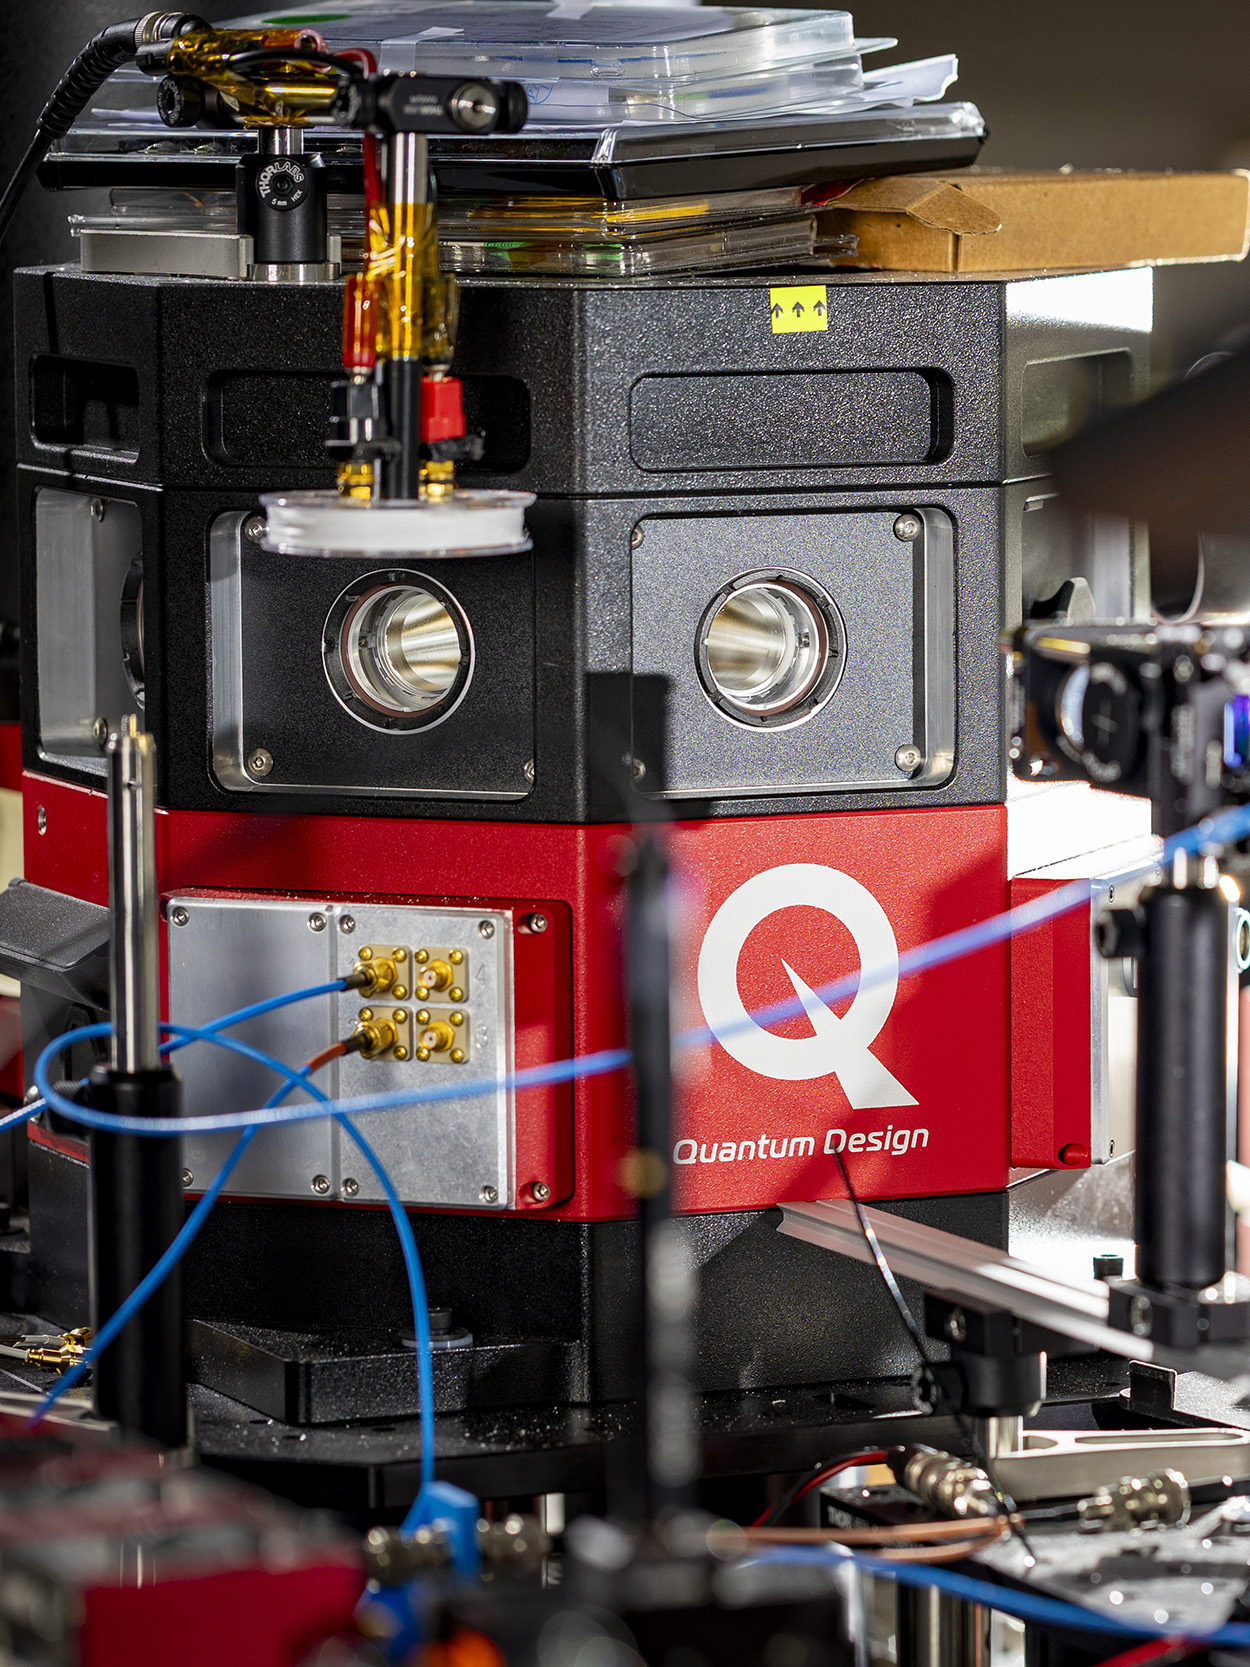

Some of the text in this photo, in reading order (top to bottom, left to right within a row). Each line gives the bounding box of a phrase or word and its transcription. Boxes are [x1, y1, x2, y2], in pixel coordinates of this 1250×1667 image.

[259, 161, 305, 198] THORLABS
[291, 189, 303, 202] HEX
[672, 1125, 929, 1166] Quantum Design
